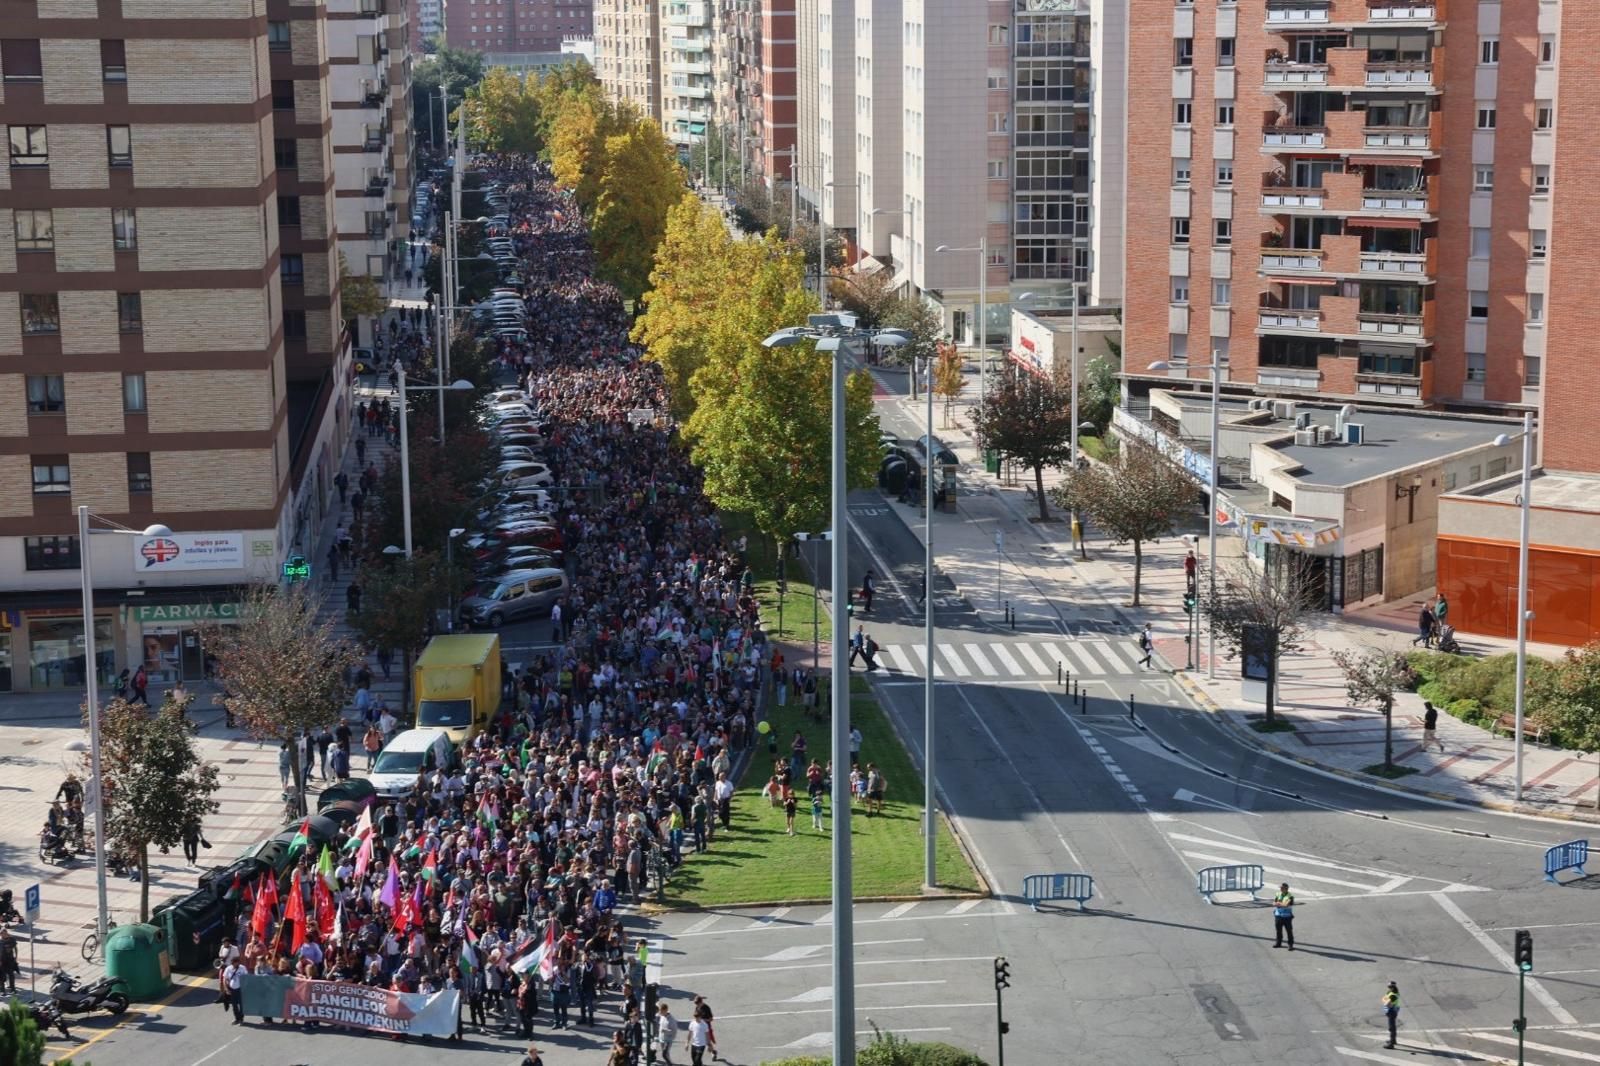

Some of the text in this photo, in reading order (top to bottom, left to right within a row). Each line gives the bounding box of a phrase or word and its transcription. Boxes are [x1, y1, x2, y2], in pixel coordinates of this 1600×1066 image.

[28, 889, 37, 908] P
[312, 983, 336, 993] ¡STOP
[311, 992, 388, 1016] LANGILEOK
[291, 1005, 410, 1031] PALESTINAREKIN!
